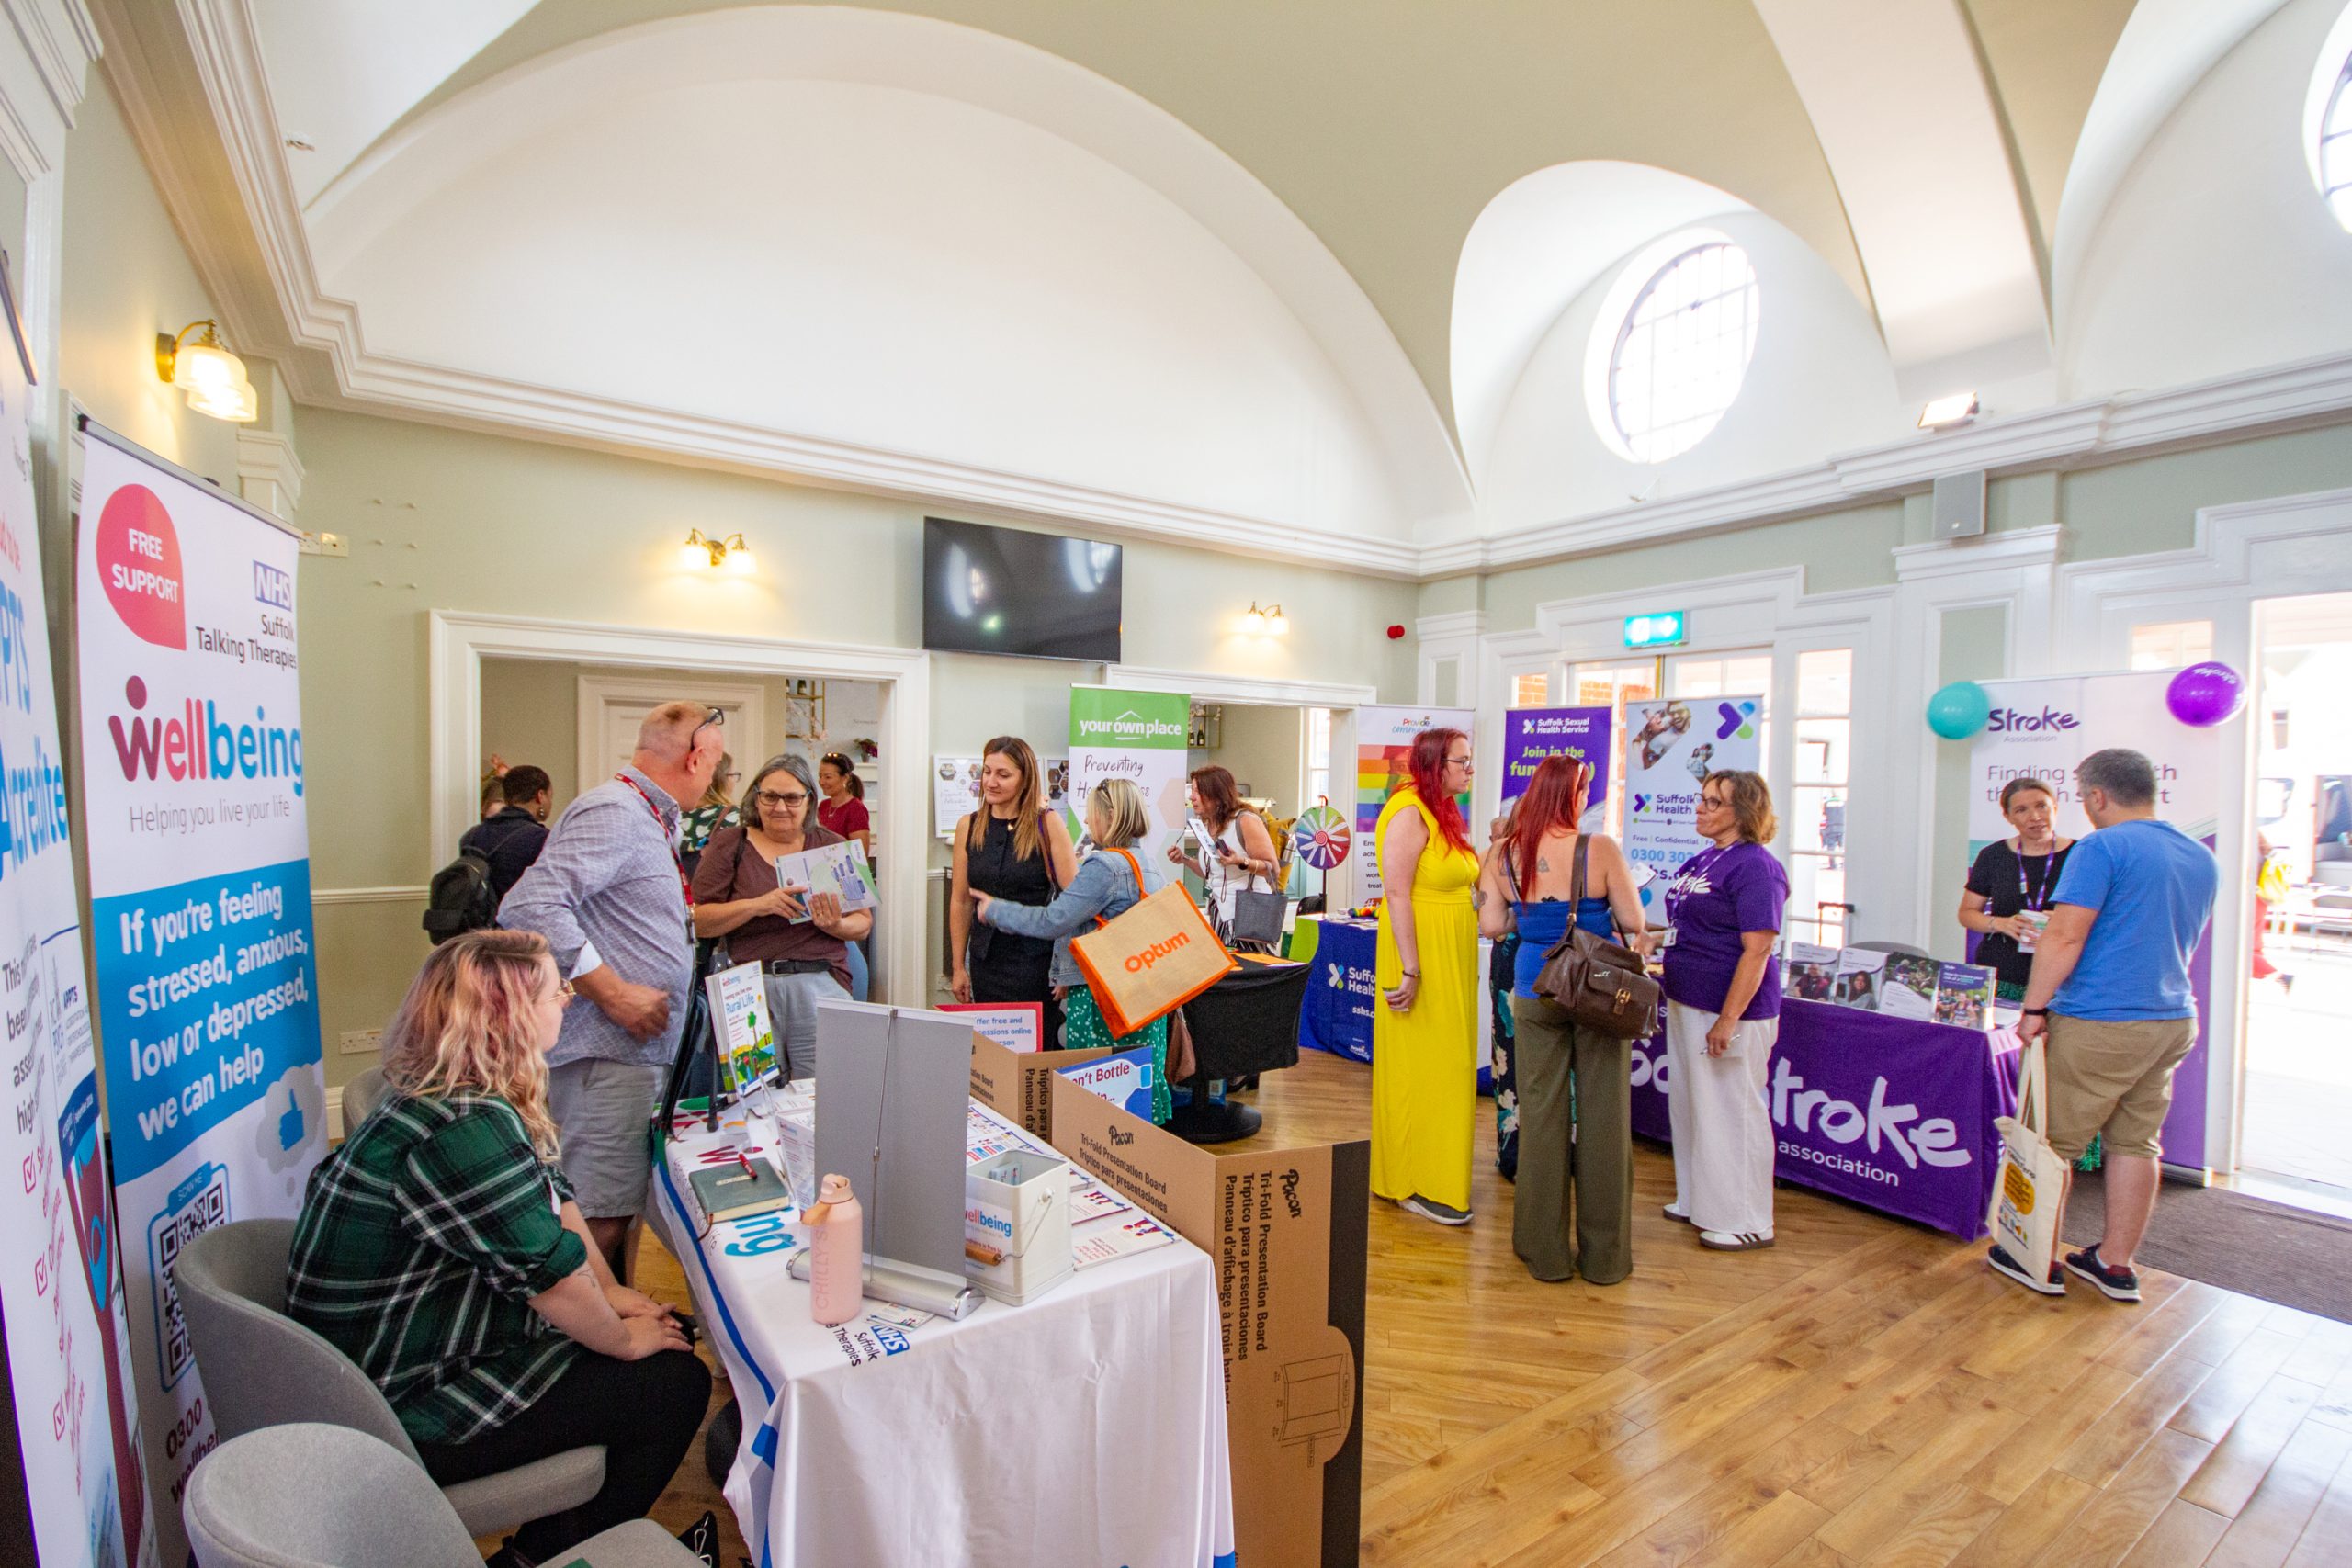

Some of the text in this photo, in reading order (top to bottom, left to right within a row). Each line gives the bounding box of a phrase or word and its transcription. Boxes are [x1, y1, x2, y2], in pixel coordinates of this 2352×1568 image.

[129, 528, 164, 561] FREE
[111, 563, 178, 603] SUPPORT
[254, 559, 292, 612] NHS
[0, 579, 30, 715] PTS
[261, 614, 294, 642] Suffolk
[195, 626, 297, 671] Talking Therapies
[1537, 717, 1590, 727] Suffolk Sexual
[1562, 725, 1589, 734] Service
[1987, 705, 2081, 733] Stroke
[2003, 733, 2058, 743] Association
[107, 696, 303, 797] wellbeing
[1083, 754, 1144, 777] Preventing
[1522, 745, 1586, 758] Join in the
[1987, 764, 2065, 785] Finding
[130, 794, 290, 837] Helping you live your life
[1656, 805, 1692, 815] Health
[1657, 794, 1695, 805] Suffolk
[1631, 848, 1666, 863] 0300
[1633, 834, 1648, 842] Free
[1655, 836, 1700, 846] Confidential
[119, 881, 283, 957] If you're feeling
[1125, 931, 1191, 974] Optum
[127, 927, 309, 1019] stressed, anxious,
[1348, 966, 1375, 984] Suffo
[1348, 980, 1375, 997] Healt
[741, 993, 754, 1008] Life
[1009, 1016, 1023, 1024] and
[130, 1032, 179, 1083] low
[183, 1017, 204, 1057] or
[207, 967, 309, 1042] depressed,
[137, 1100, 179, 1142] we
[181, 1078, 216, 1115] can
[219, 1043, 265, 1093] help
[1025, 1068, 1035, 1111] Panneau
[1072, 1062, 1130, 1086] on't Bottle
[1036, 1067, 1049, 1132] Triptico para
[1771, 1056, 1973, 1170] troke
[1108, 1125, 1135, 1146] Pacon
[1079, 1147, 1168, 1213] Triptico para presentaciones
[1080, 1133, 1167, 1195] Tri-Fold Presentation Board
[1778, 1140, 1900, 1187] association
[1224, 1174, 1238, 1233] Panneau
[1279, 1168, 1302, 1219] Pacon
[815, 1230, 829, 1311] CHILLY'S
[1219, 1235, 1237, 1307] d'affichage
[1238, 1172, 1255, 1361] Triptico para presentaciones
[1255, 1170, 1272, 1352] Tri-Fold Presentation Board
[1223, 1310, 1231, 1319] à
[832, 1326, 862, 1367] Therapies
[854, 1330, 881, 1363] Suffolk
[870, 1325, 910, 1357] NHS
[1222, 1322, 1232, 1358] trois
[165, 1396, 203, 1461] 0300
